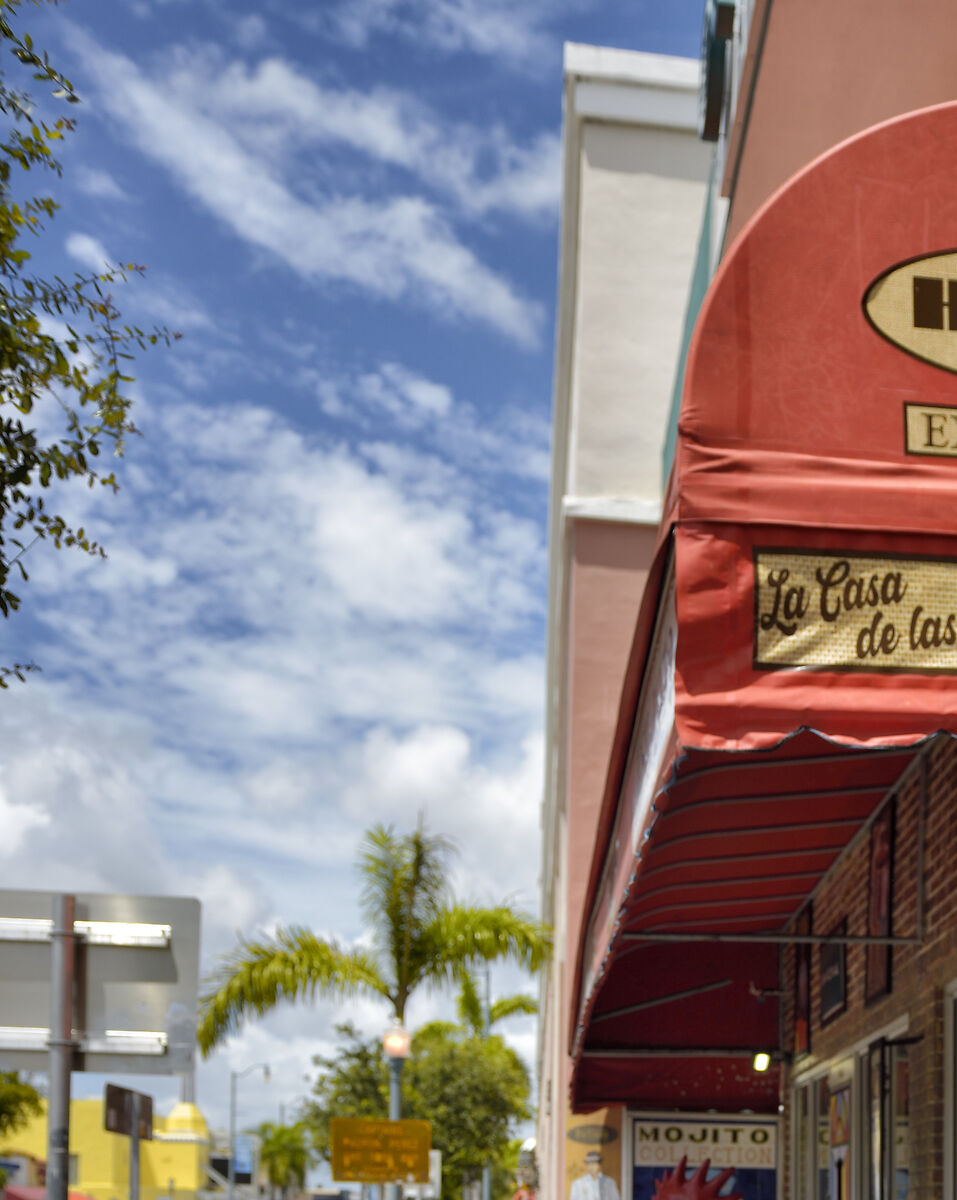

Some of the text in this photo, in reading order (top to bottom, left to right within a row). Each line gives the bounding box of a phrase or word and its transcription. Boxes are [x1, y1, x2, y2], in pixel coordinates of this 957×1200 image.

[761, 560, 908, 636] La Casa
[856, 606, 956, 660] de las
[639, 1126, 769, 1144] MOJITO
[639, 1145, 772, 1165] COLLECTION
